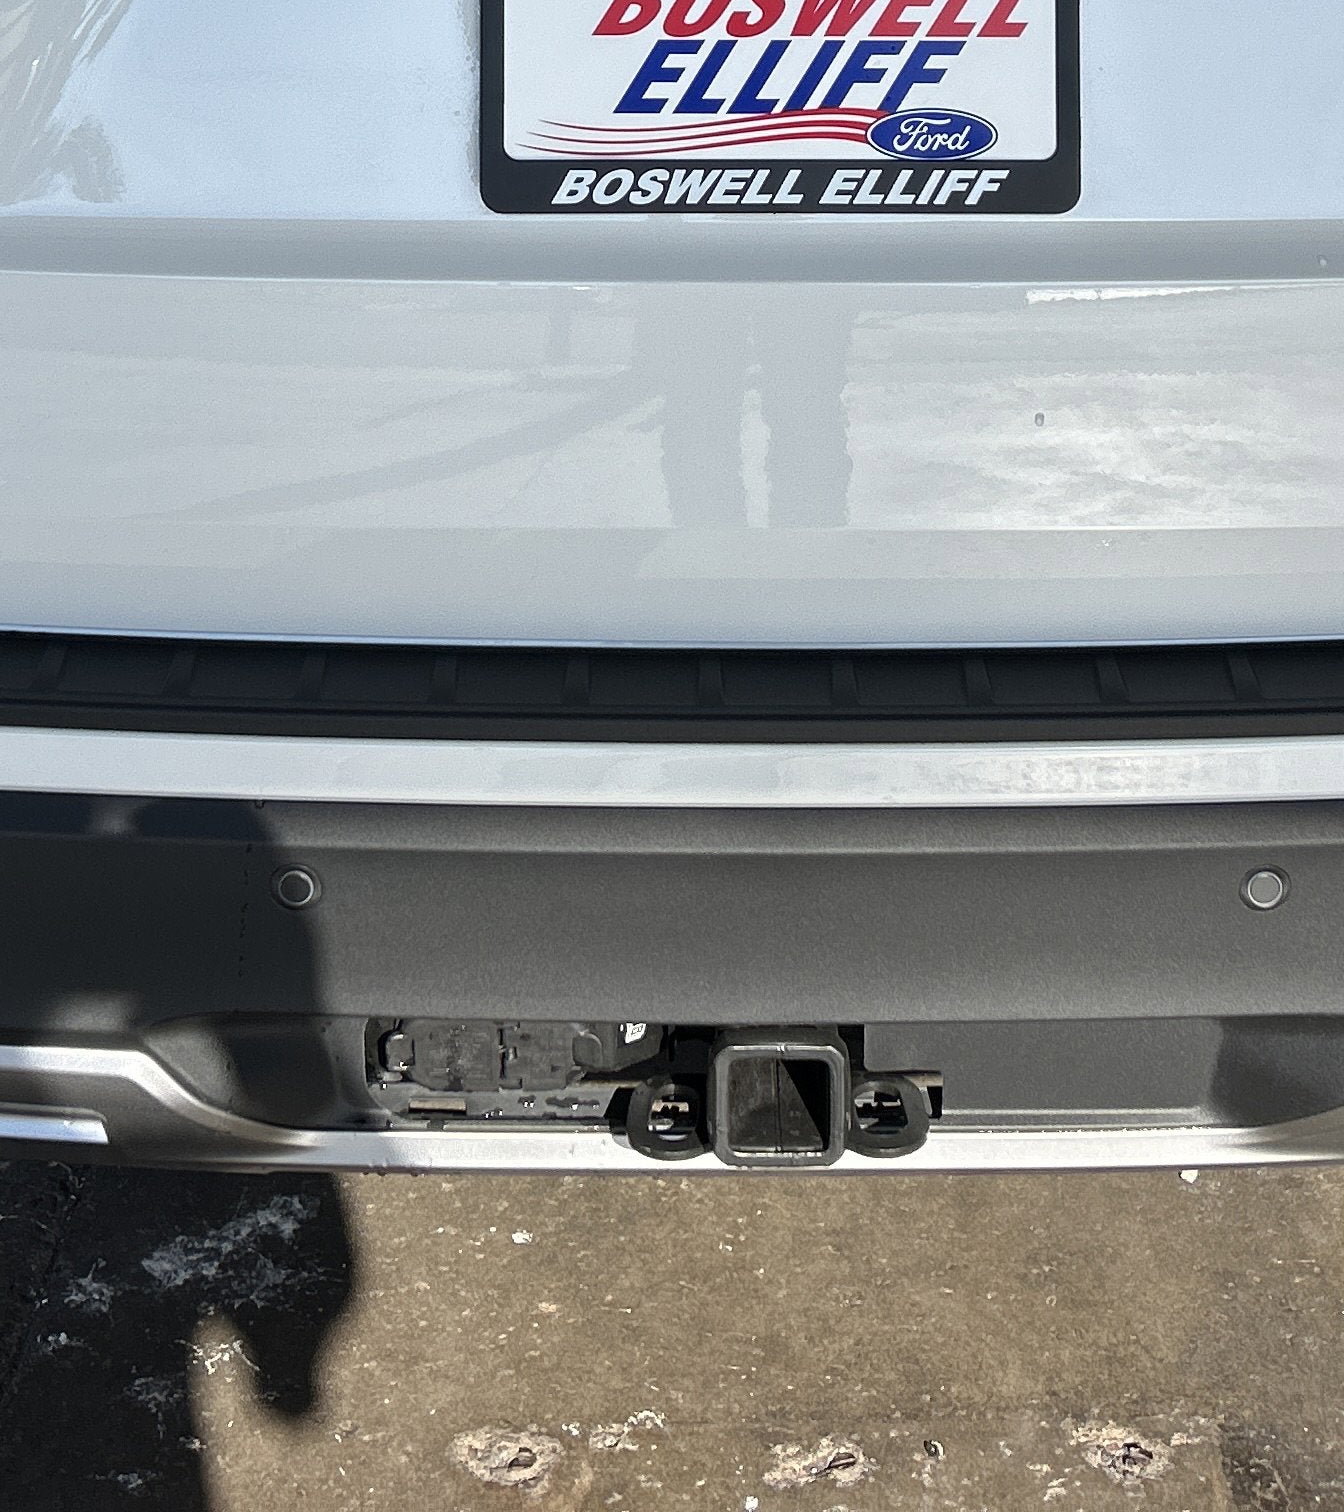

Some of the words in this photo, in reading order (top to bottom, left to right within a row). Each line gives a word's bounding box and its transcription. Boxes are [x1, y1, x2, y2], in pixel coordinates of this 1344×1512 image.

[612, 39, 967, 115] ELLIFF
[892, 117, 971, 152] Ford
[551, 168, 807, 206] BOSWELL
[818, 168, 1010, 206] ELLIFF
